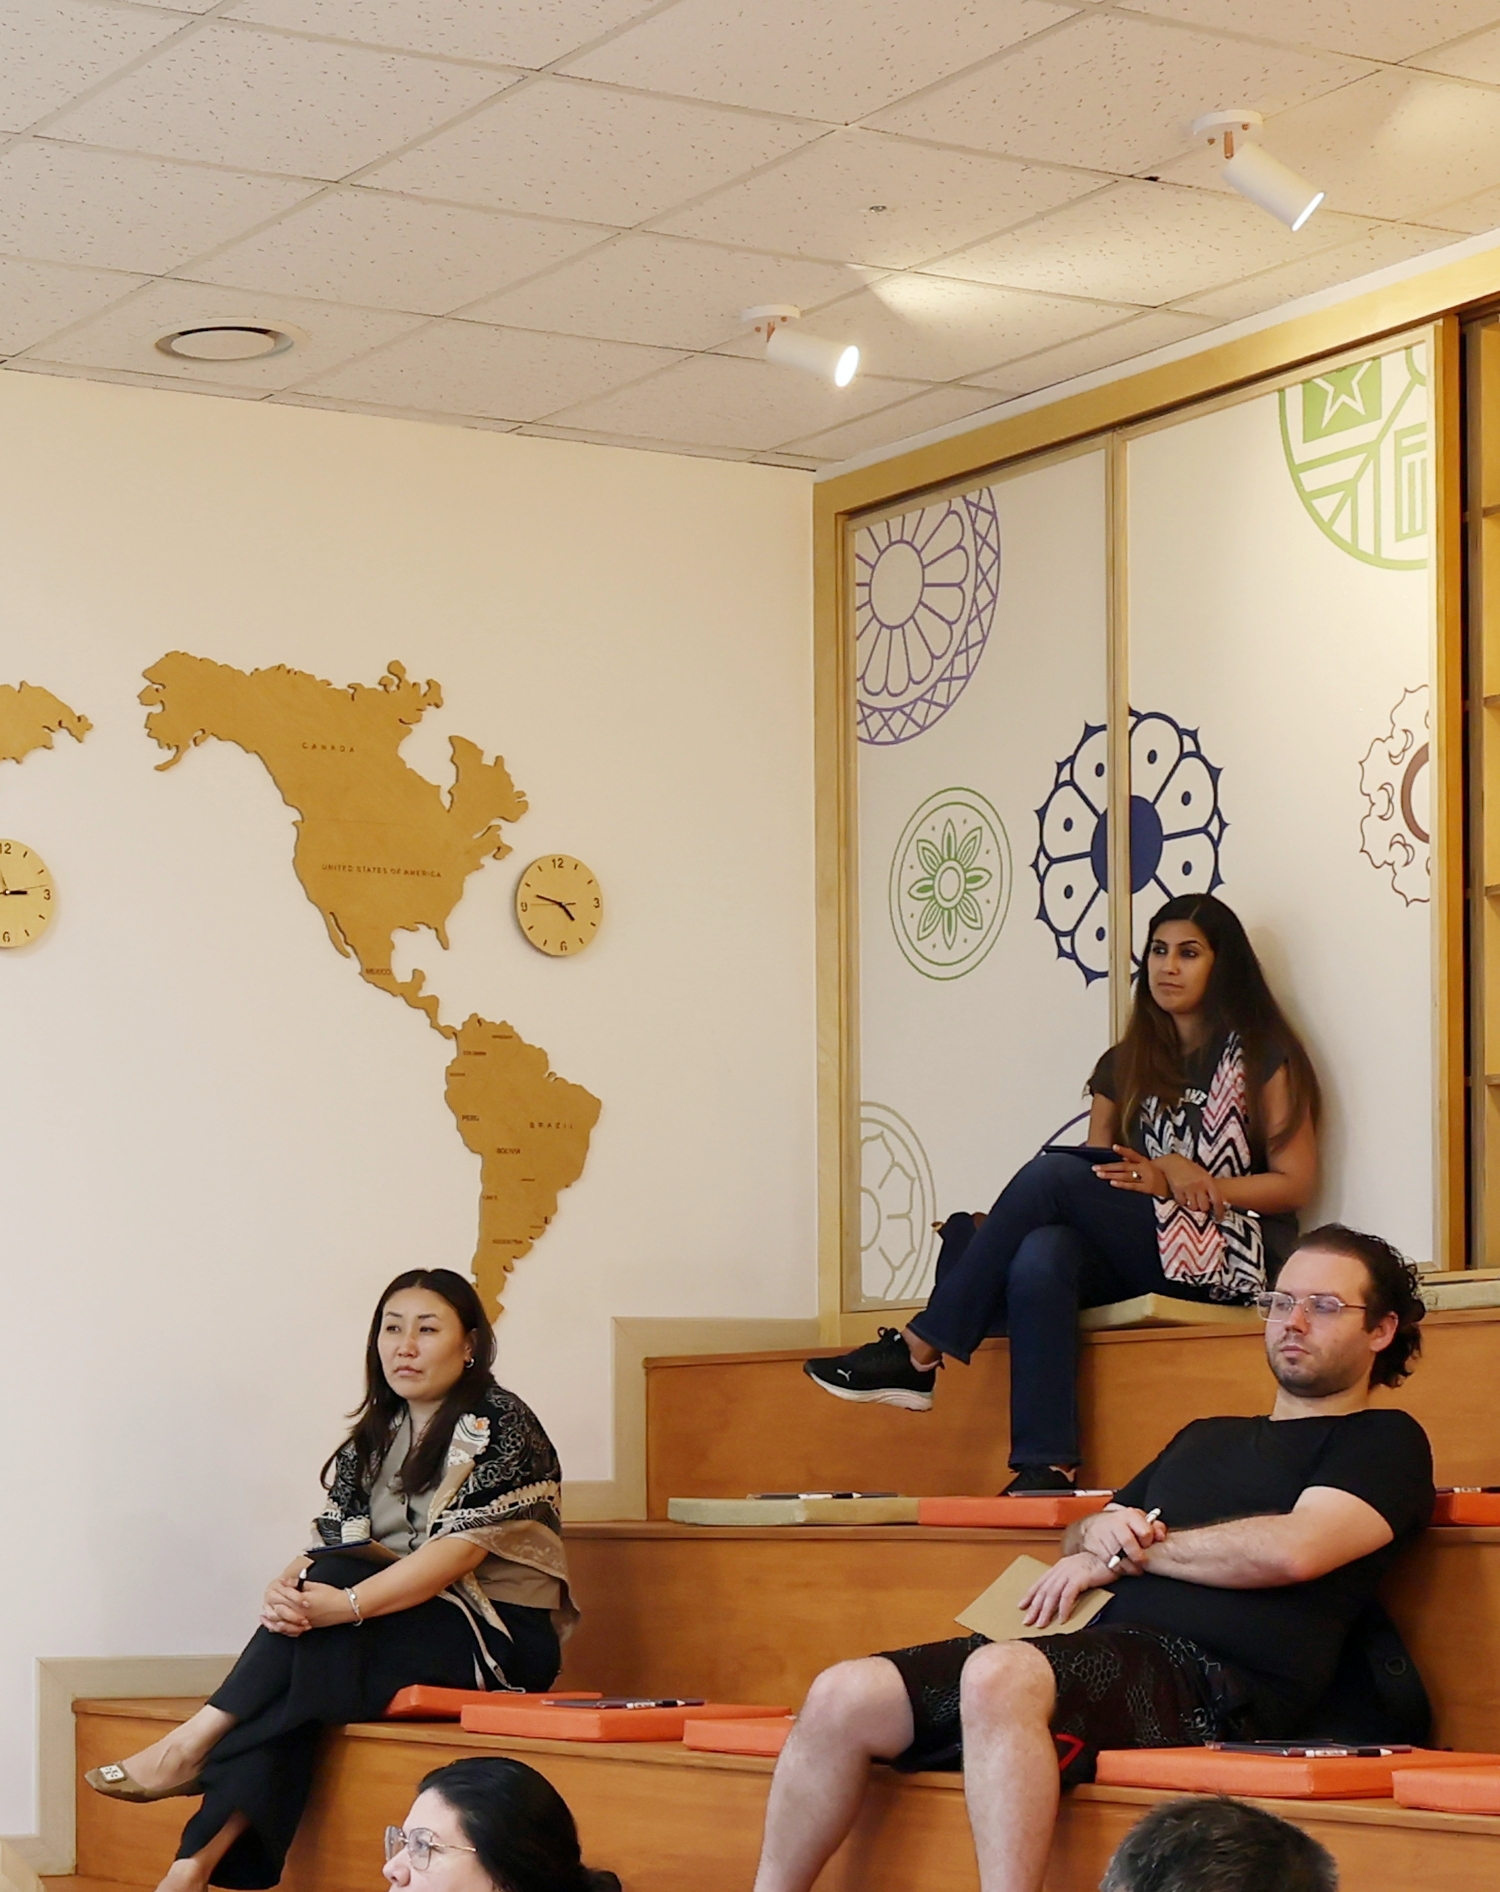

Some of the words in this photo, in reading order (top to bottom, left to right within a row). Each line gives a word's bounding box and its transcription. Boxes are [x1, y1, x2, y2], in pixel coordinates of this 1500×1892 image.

[302, 742, 355, 752] CANADA
[551, 857, 564, 869] 12
[322, 864, 354, 872] UNITED
[356, 866, 388, 875] STATES
[403, 869, 442, 878] AMERICA
[43, 888, 52, 901] 3
[593, 897, 601, 909] 3
[2, 931, 11, 943] 6
[560, 940, 568, 951] 6
[365, 968, 391, 976] MEXICO
